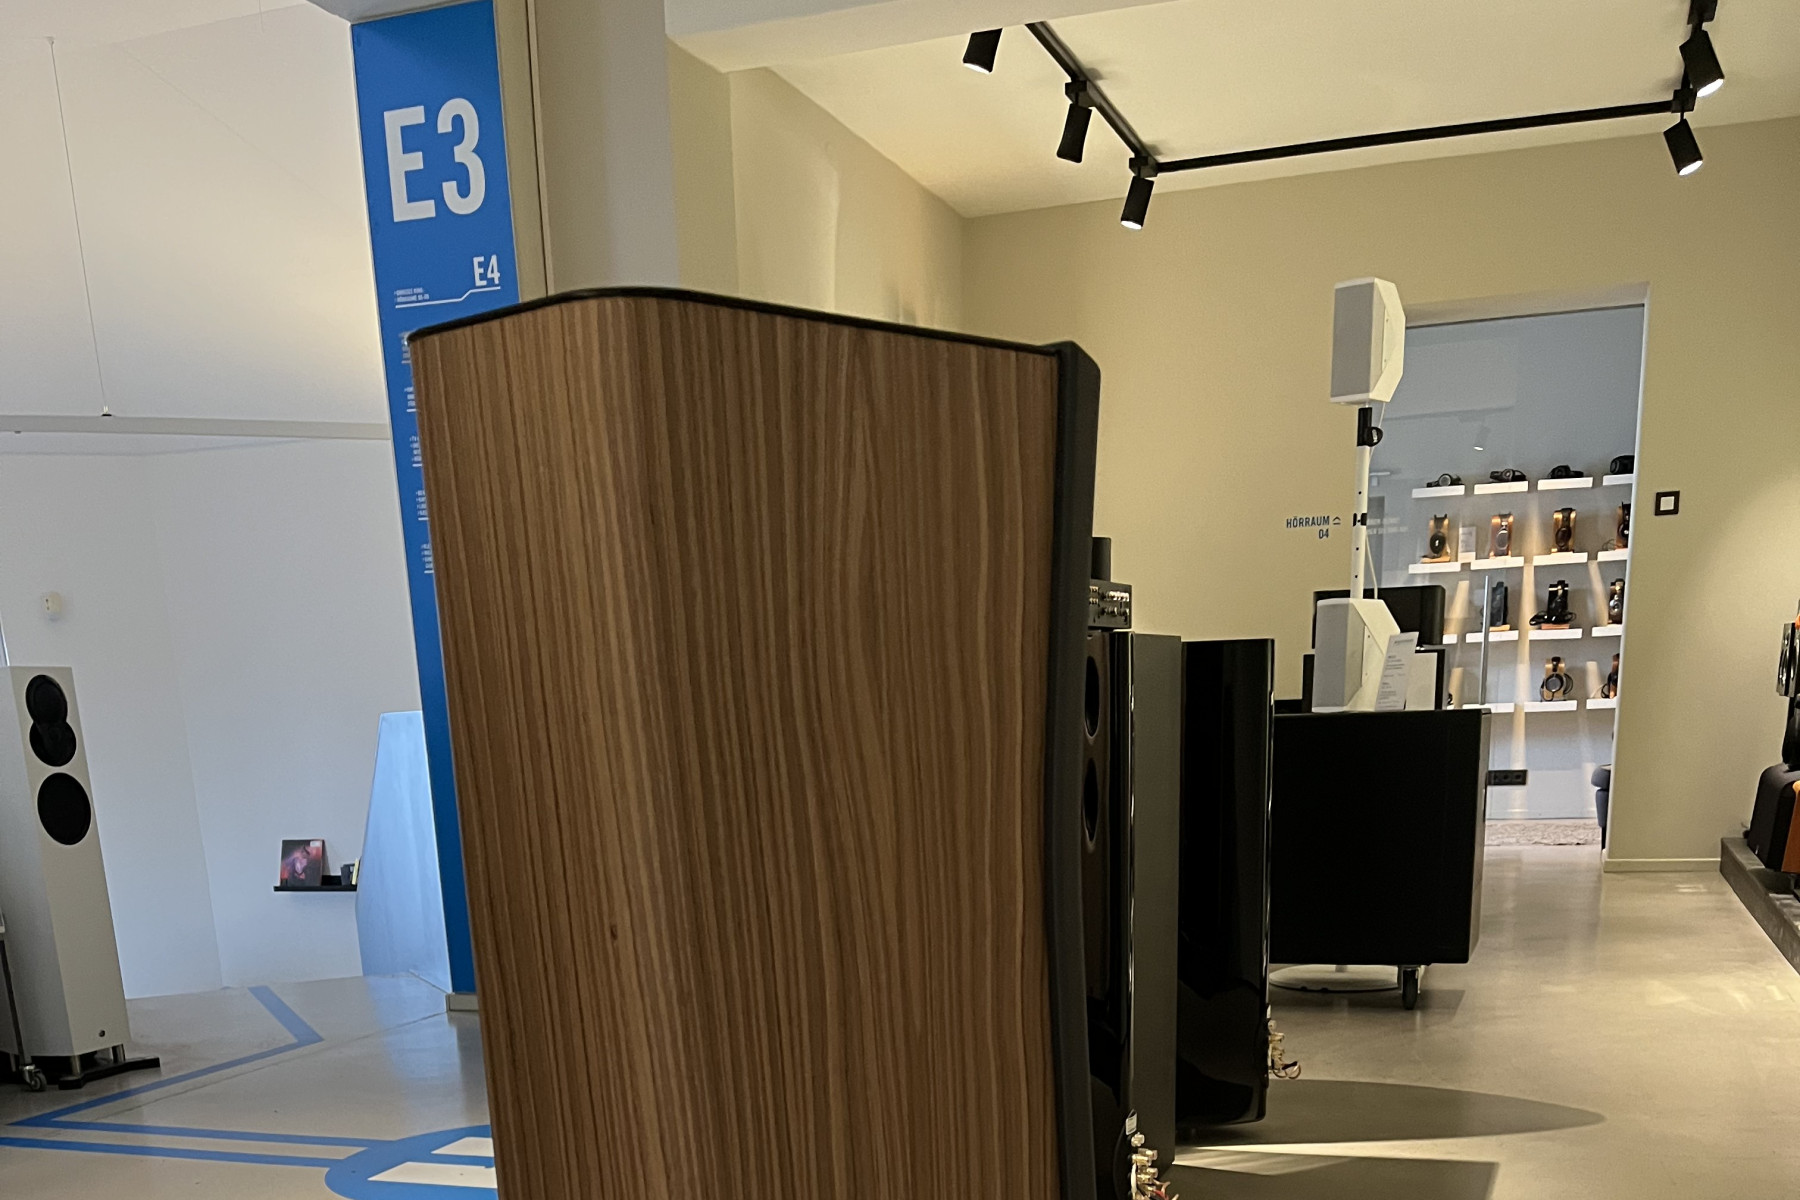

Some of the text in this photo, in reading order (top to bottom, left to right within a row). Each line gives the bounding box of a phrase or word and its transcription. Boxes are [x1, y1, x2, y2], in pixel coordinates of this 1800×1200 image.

[384, 97, 486, 222] E3
[473, 254, 501, 286] E4
[1286, 515, 1330, 528] HÖRRAUM
[1318, 528, 1330, 539] 04
